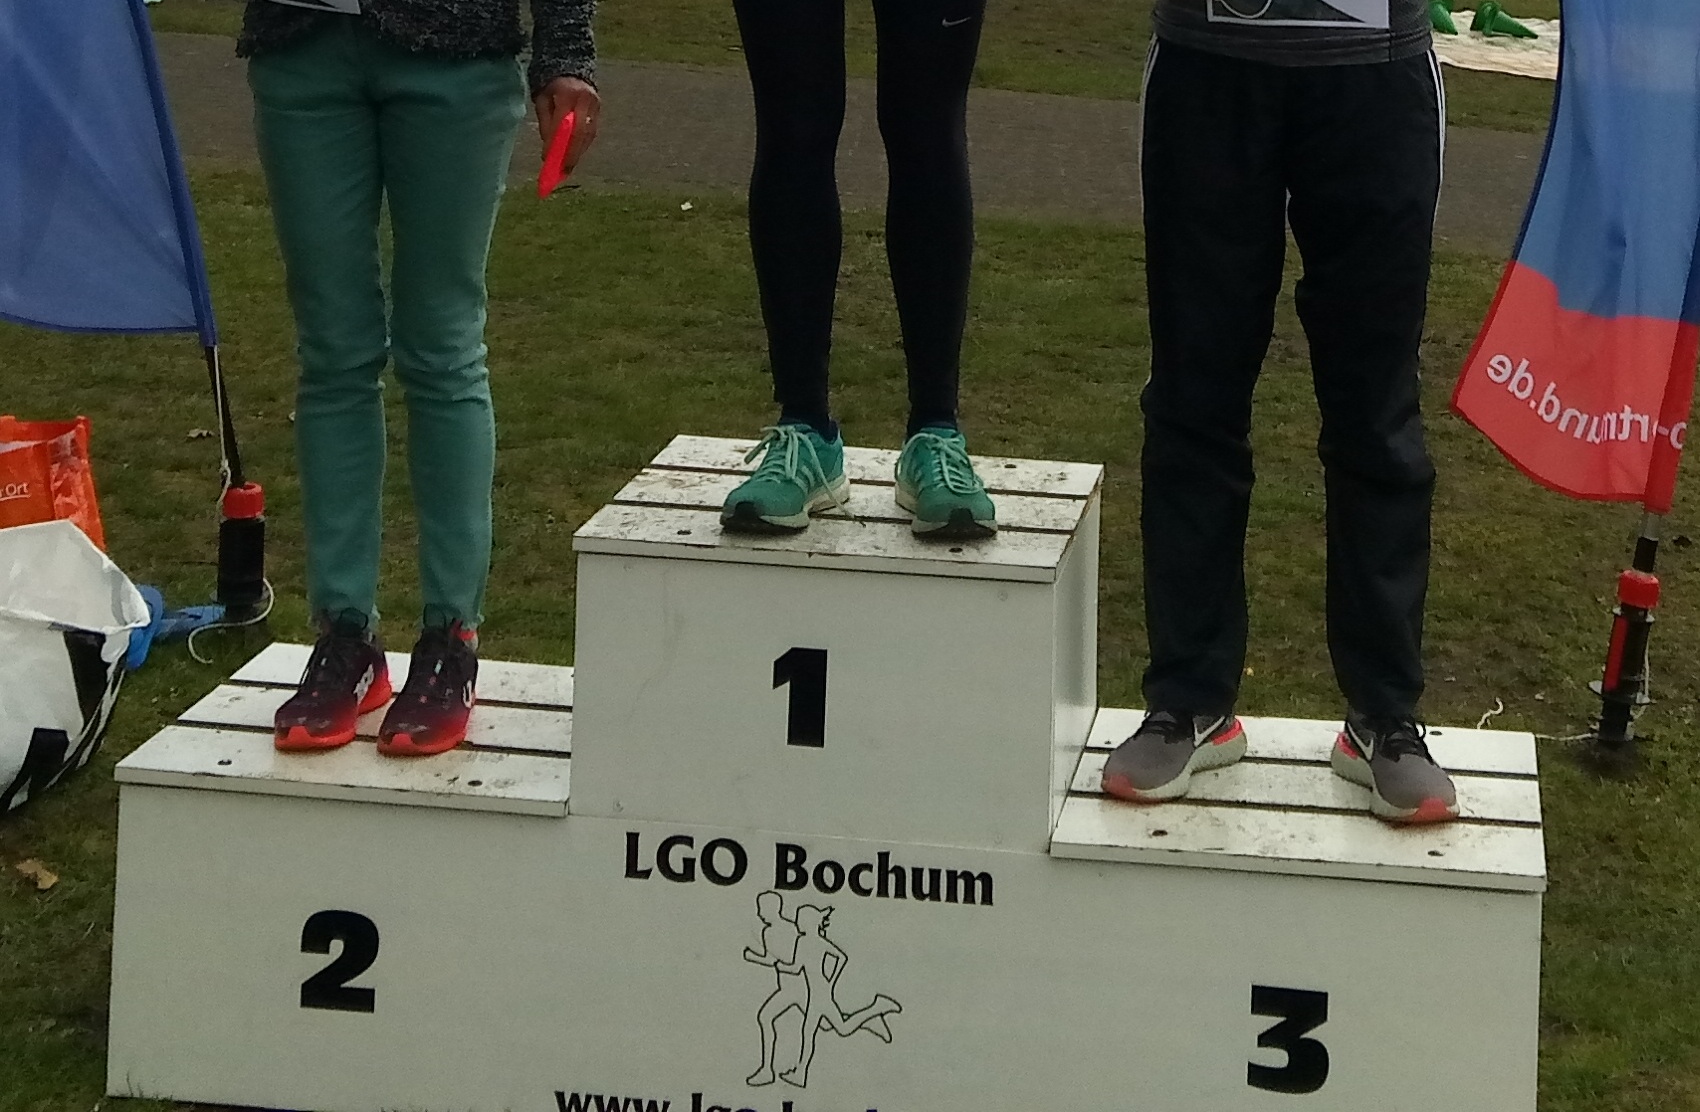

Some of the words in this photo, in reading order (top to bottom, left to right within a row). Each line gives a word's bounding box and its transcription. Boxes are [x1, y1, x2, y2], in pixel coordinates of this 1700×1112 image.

[5, 482, 29, 497] Ort
[772, 647, 828, 748] 1
[624, 831, 748, 887] LGO
[774, 842, 994, 907] Bochum
[299, 909, 380, 1014] 2
[1247, 984, 1330, 1095] 3
